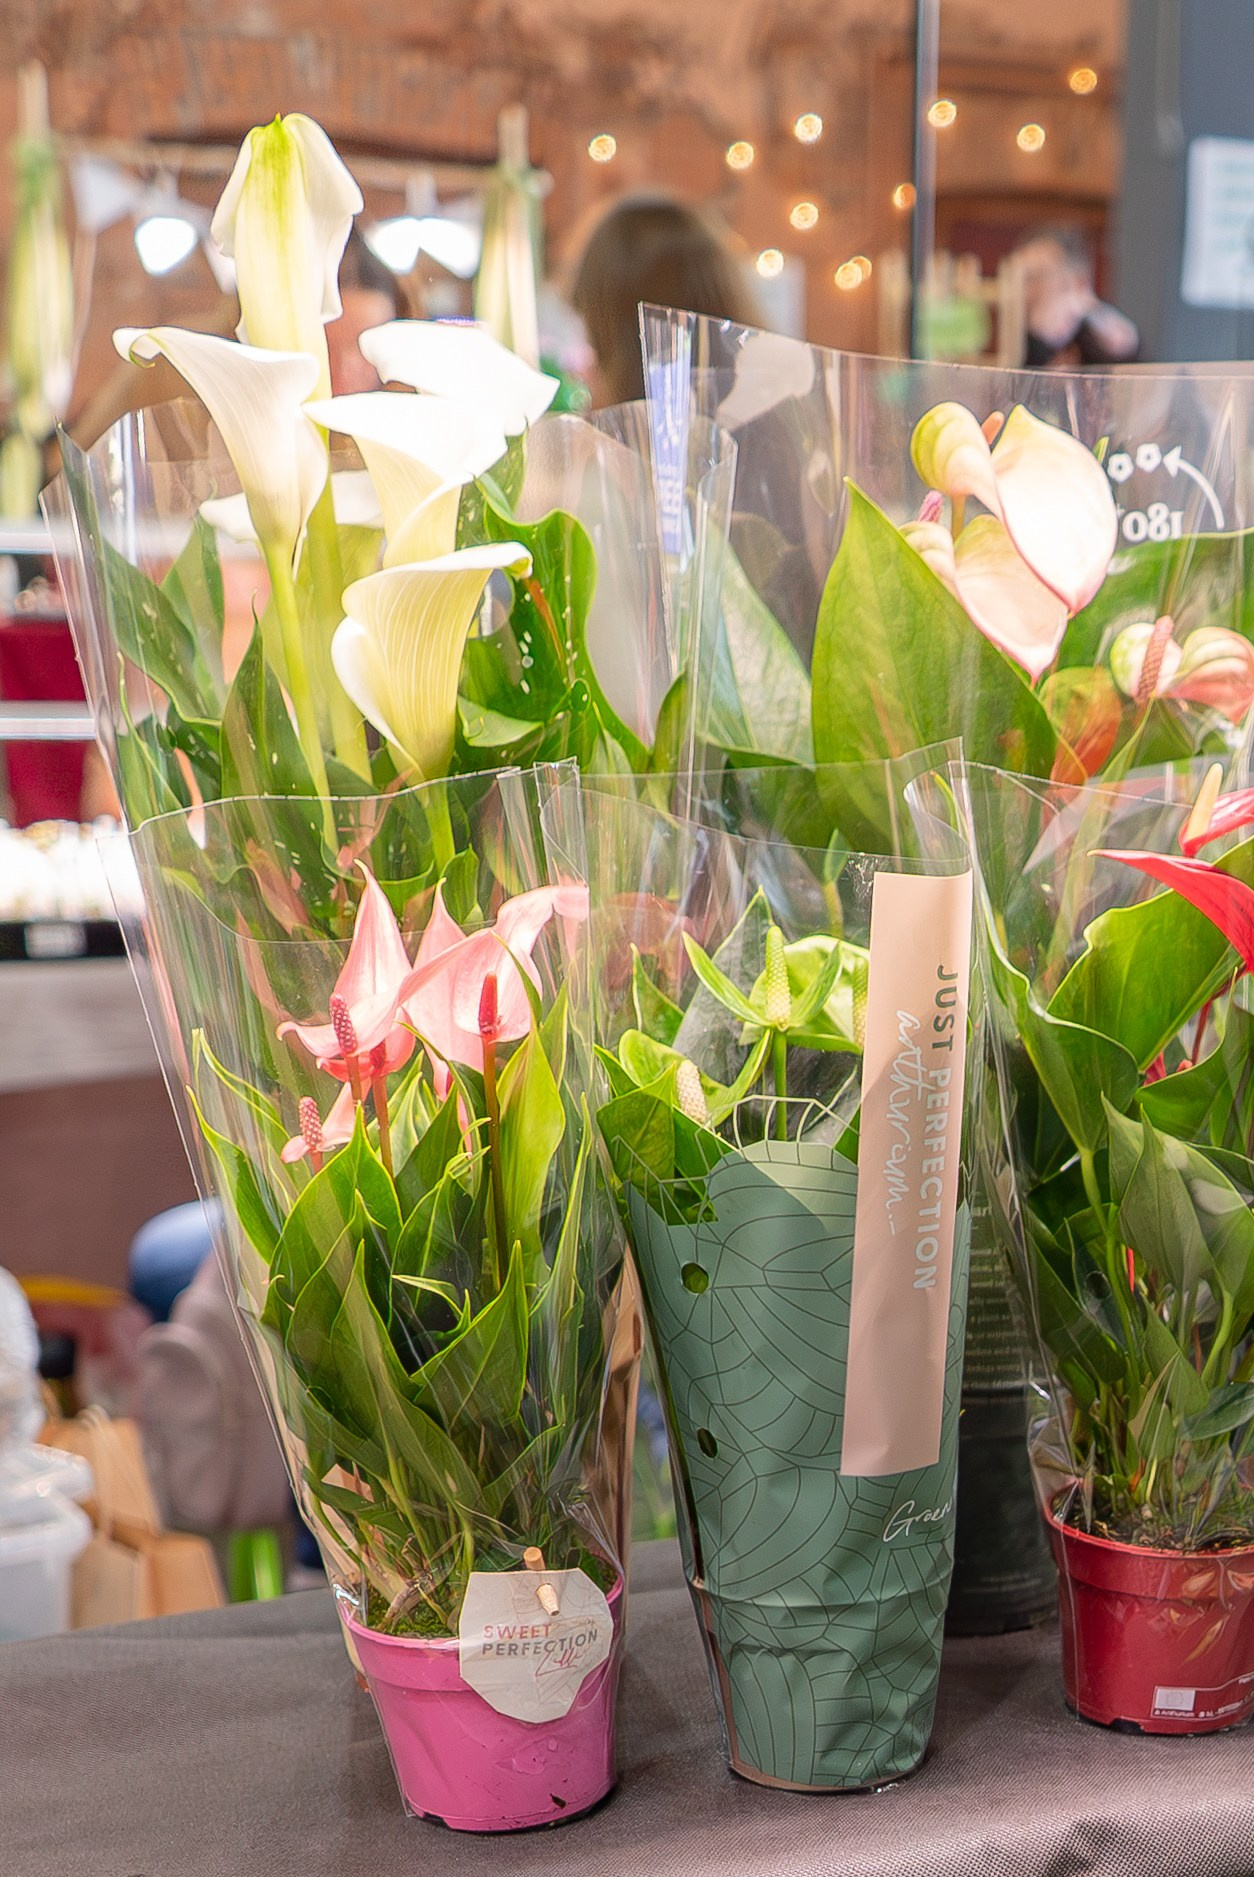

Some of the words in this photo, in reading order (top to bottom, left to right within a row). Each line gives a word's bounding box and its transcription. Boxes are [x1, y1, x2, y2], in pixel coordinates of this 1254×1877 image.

[932, 964, 958, 1051] JUST
[913, 1068, 952, 1289] PERFECTION
[482, 1629, 598, 1655] PERFECTION
[484, 1624, 551, 1639] SWEET
